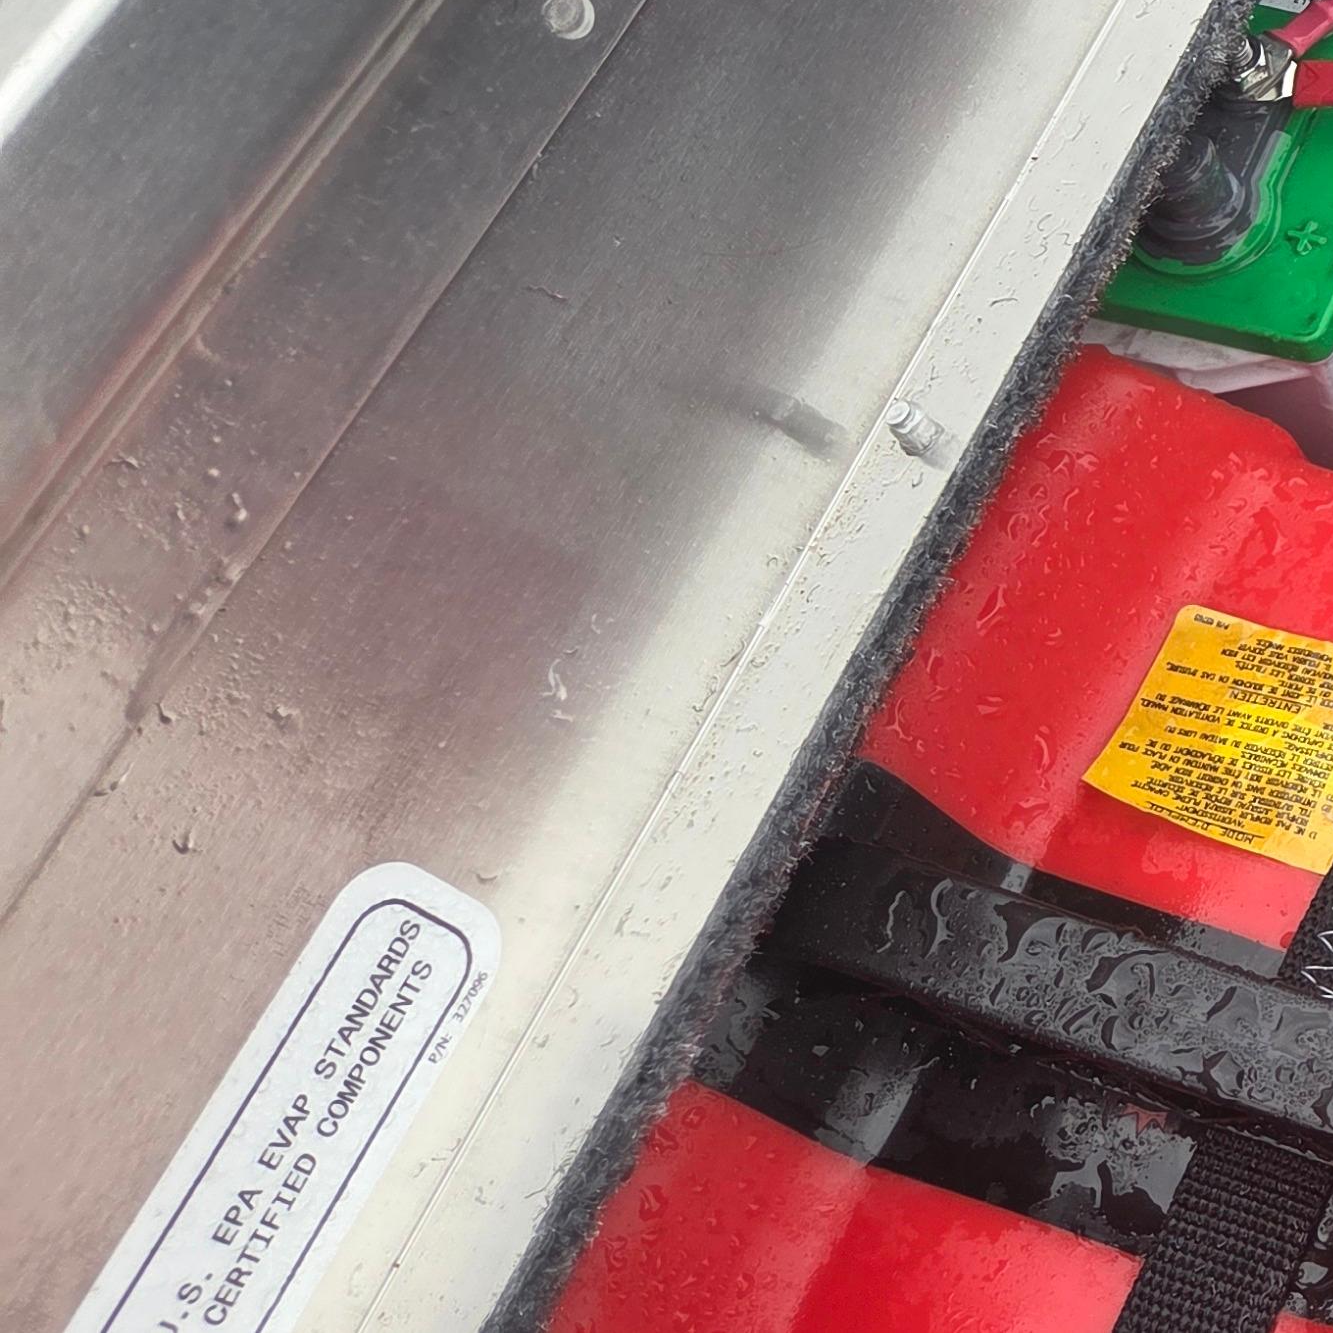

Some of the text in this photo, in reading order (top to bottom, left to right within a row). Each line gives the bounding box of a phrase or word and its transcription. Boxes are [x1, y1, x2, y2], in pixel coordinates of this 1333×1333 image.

[204, 960, 432, 1325] CERTIFIED COMPONENTS
[212, 920, 420, 1245] EPA EVAP STANDARDS
